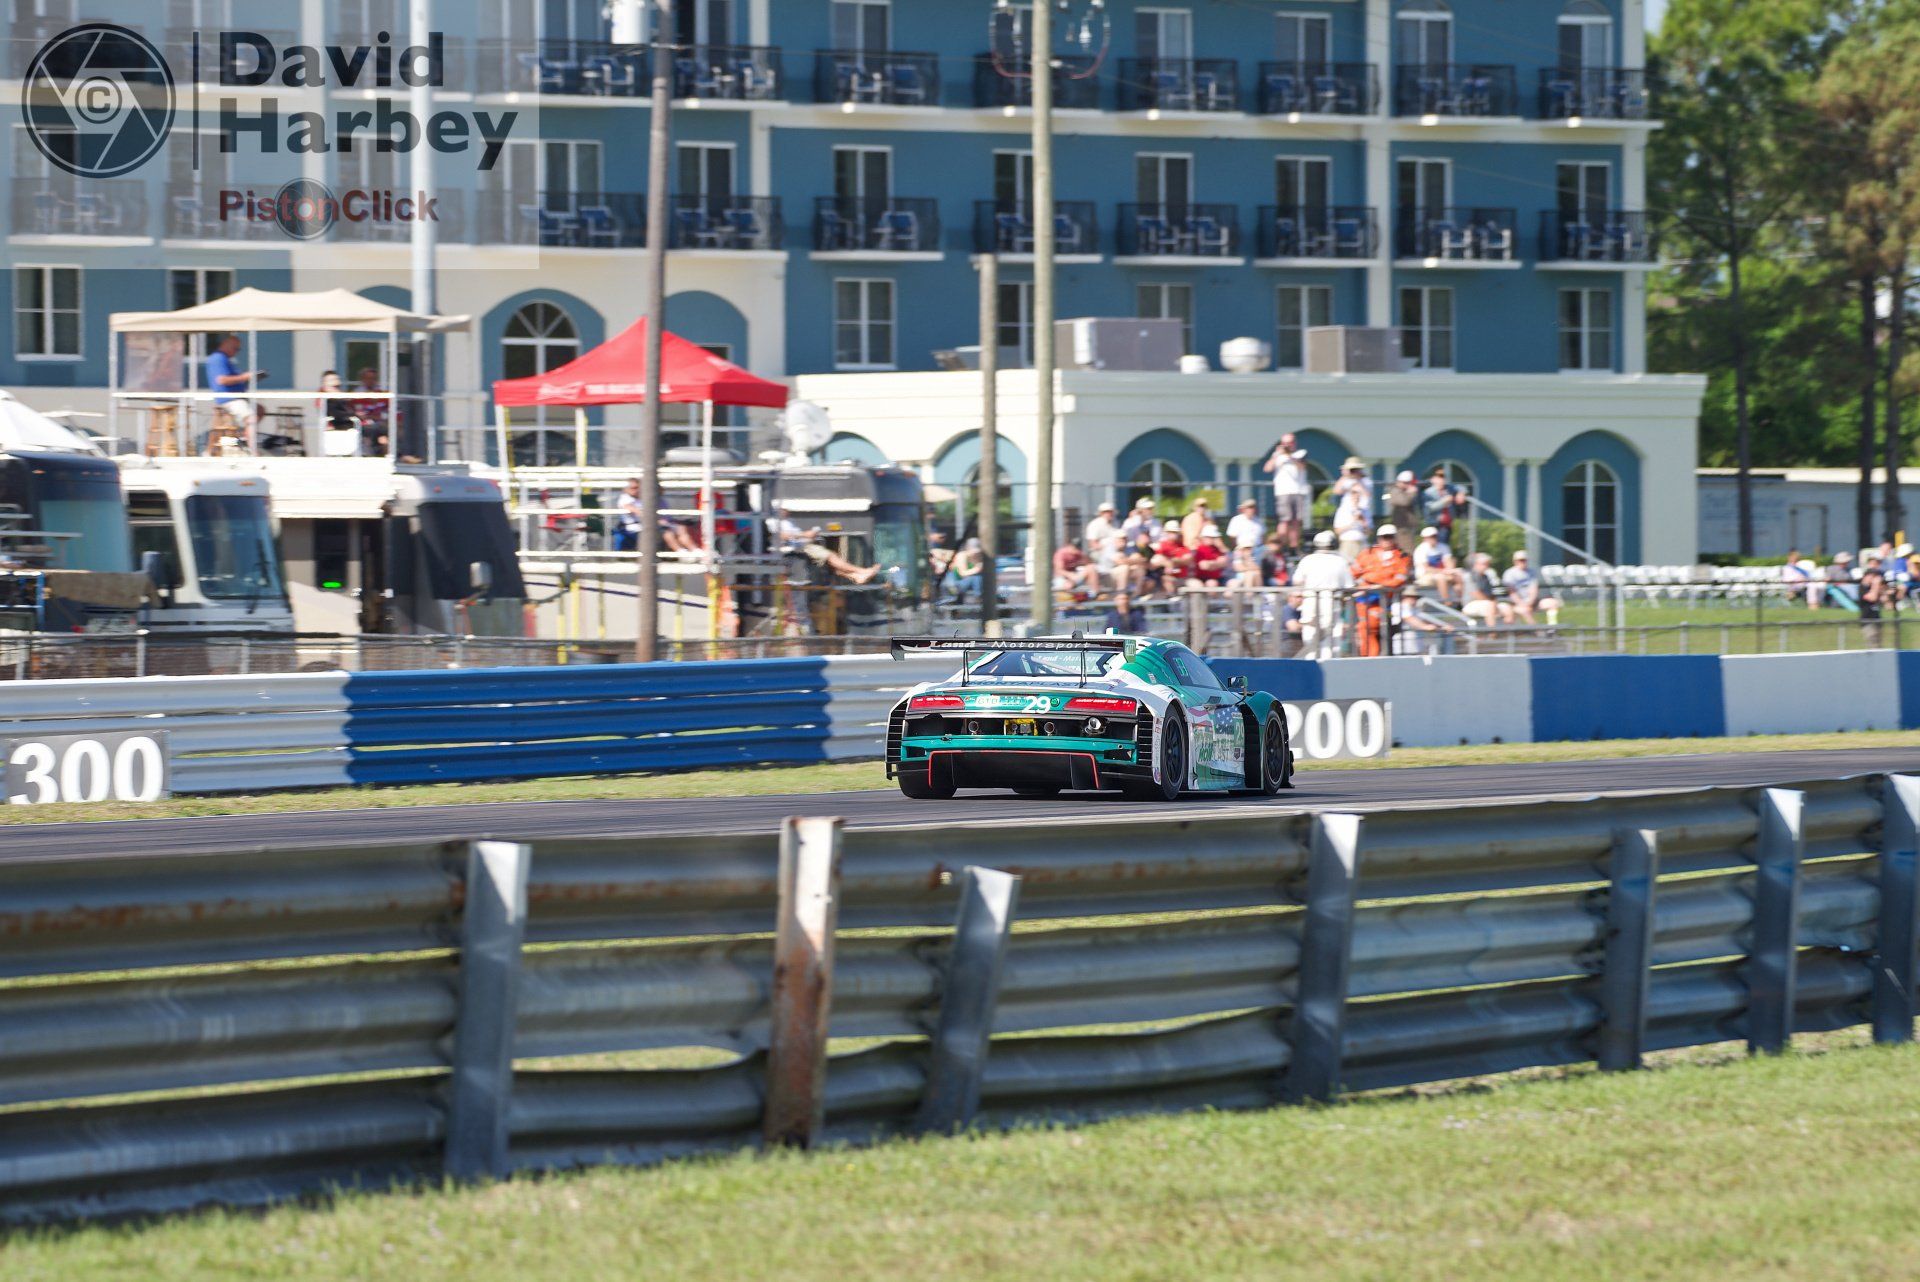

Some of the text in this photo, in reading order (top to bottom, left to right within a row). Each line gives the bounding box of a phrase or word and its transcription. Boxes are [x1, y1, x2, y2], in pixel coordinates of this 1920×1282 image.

[1022, 696, 1051, 714] 29
[1283, 699, 1385, 759] 200
[9, 736, 164, 805] 300
